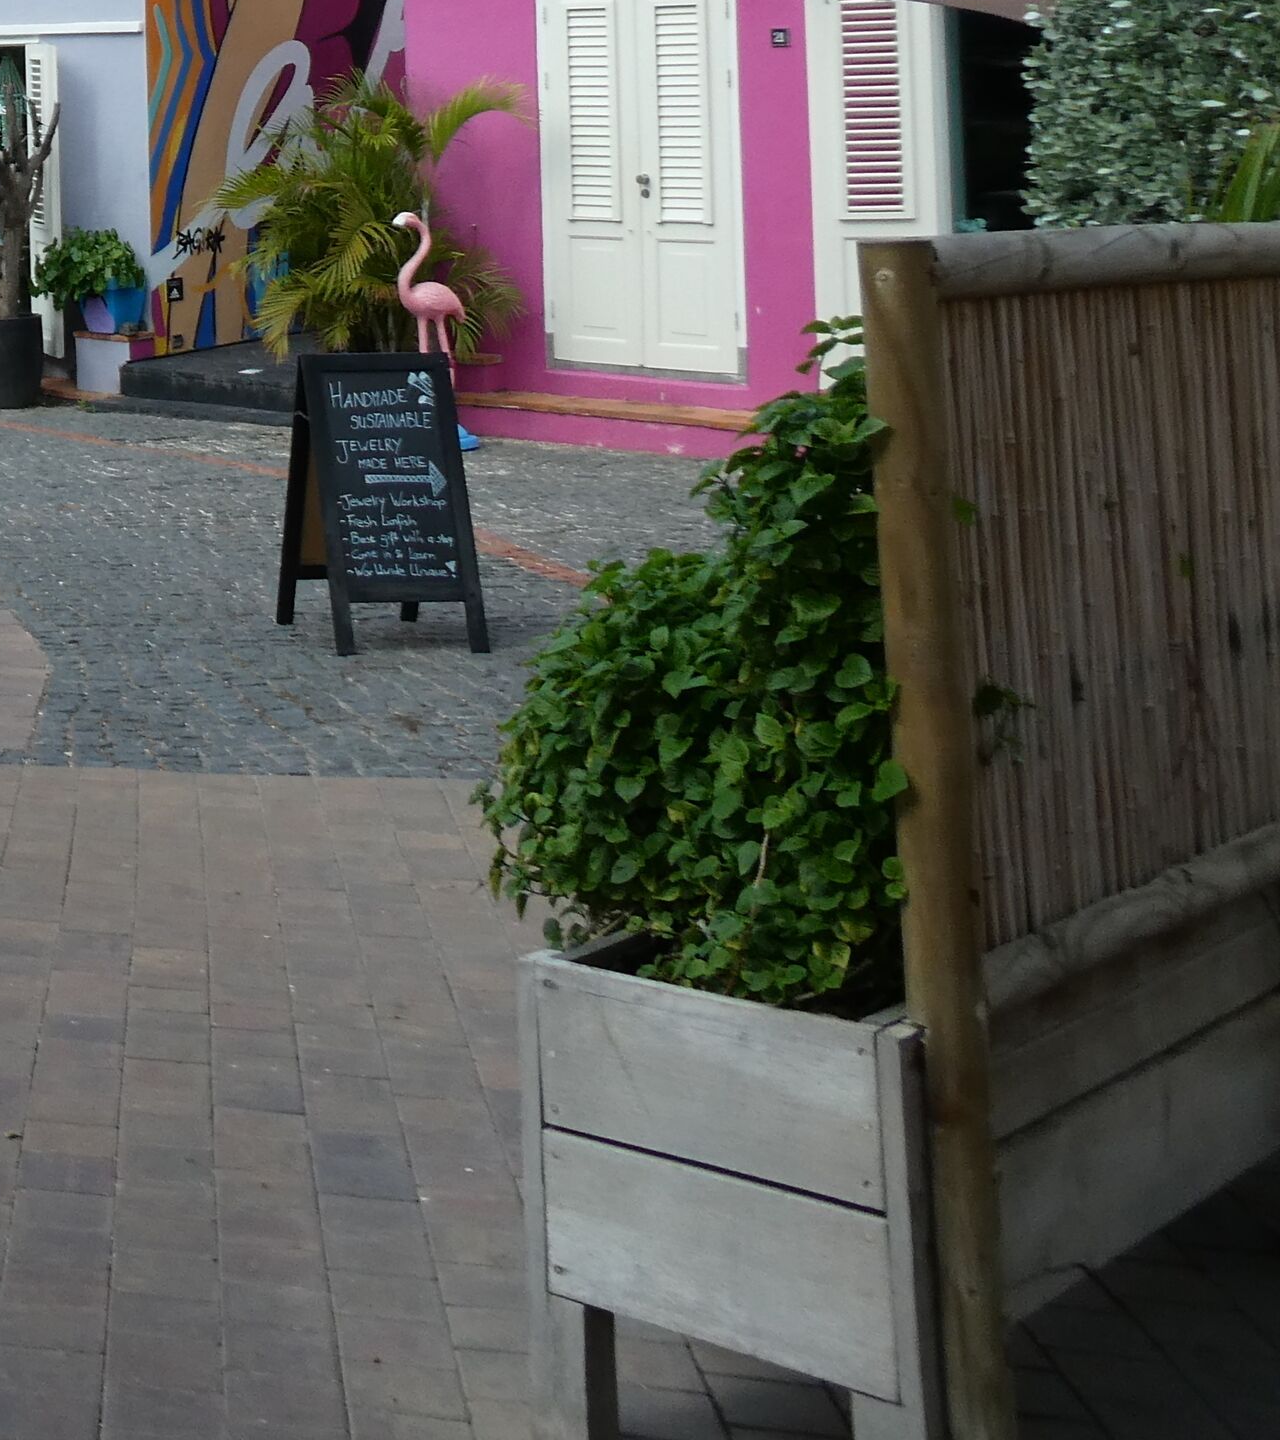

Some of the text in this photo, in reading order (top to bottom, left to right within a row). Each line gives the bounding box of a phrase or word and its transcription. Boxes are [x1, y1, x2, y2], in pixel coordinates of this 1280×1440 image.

[329, 381, 408, 408] HANDMADE
[350, 411, 432, 429] SUSTAINABLE
[335, 438, 402, 464] JEWELRY
[358, 456, 428, 469] MADE HERE
[389, 491, 447, 510] Workshop
